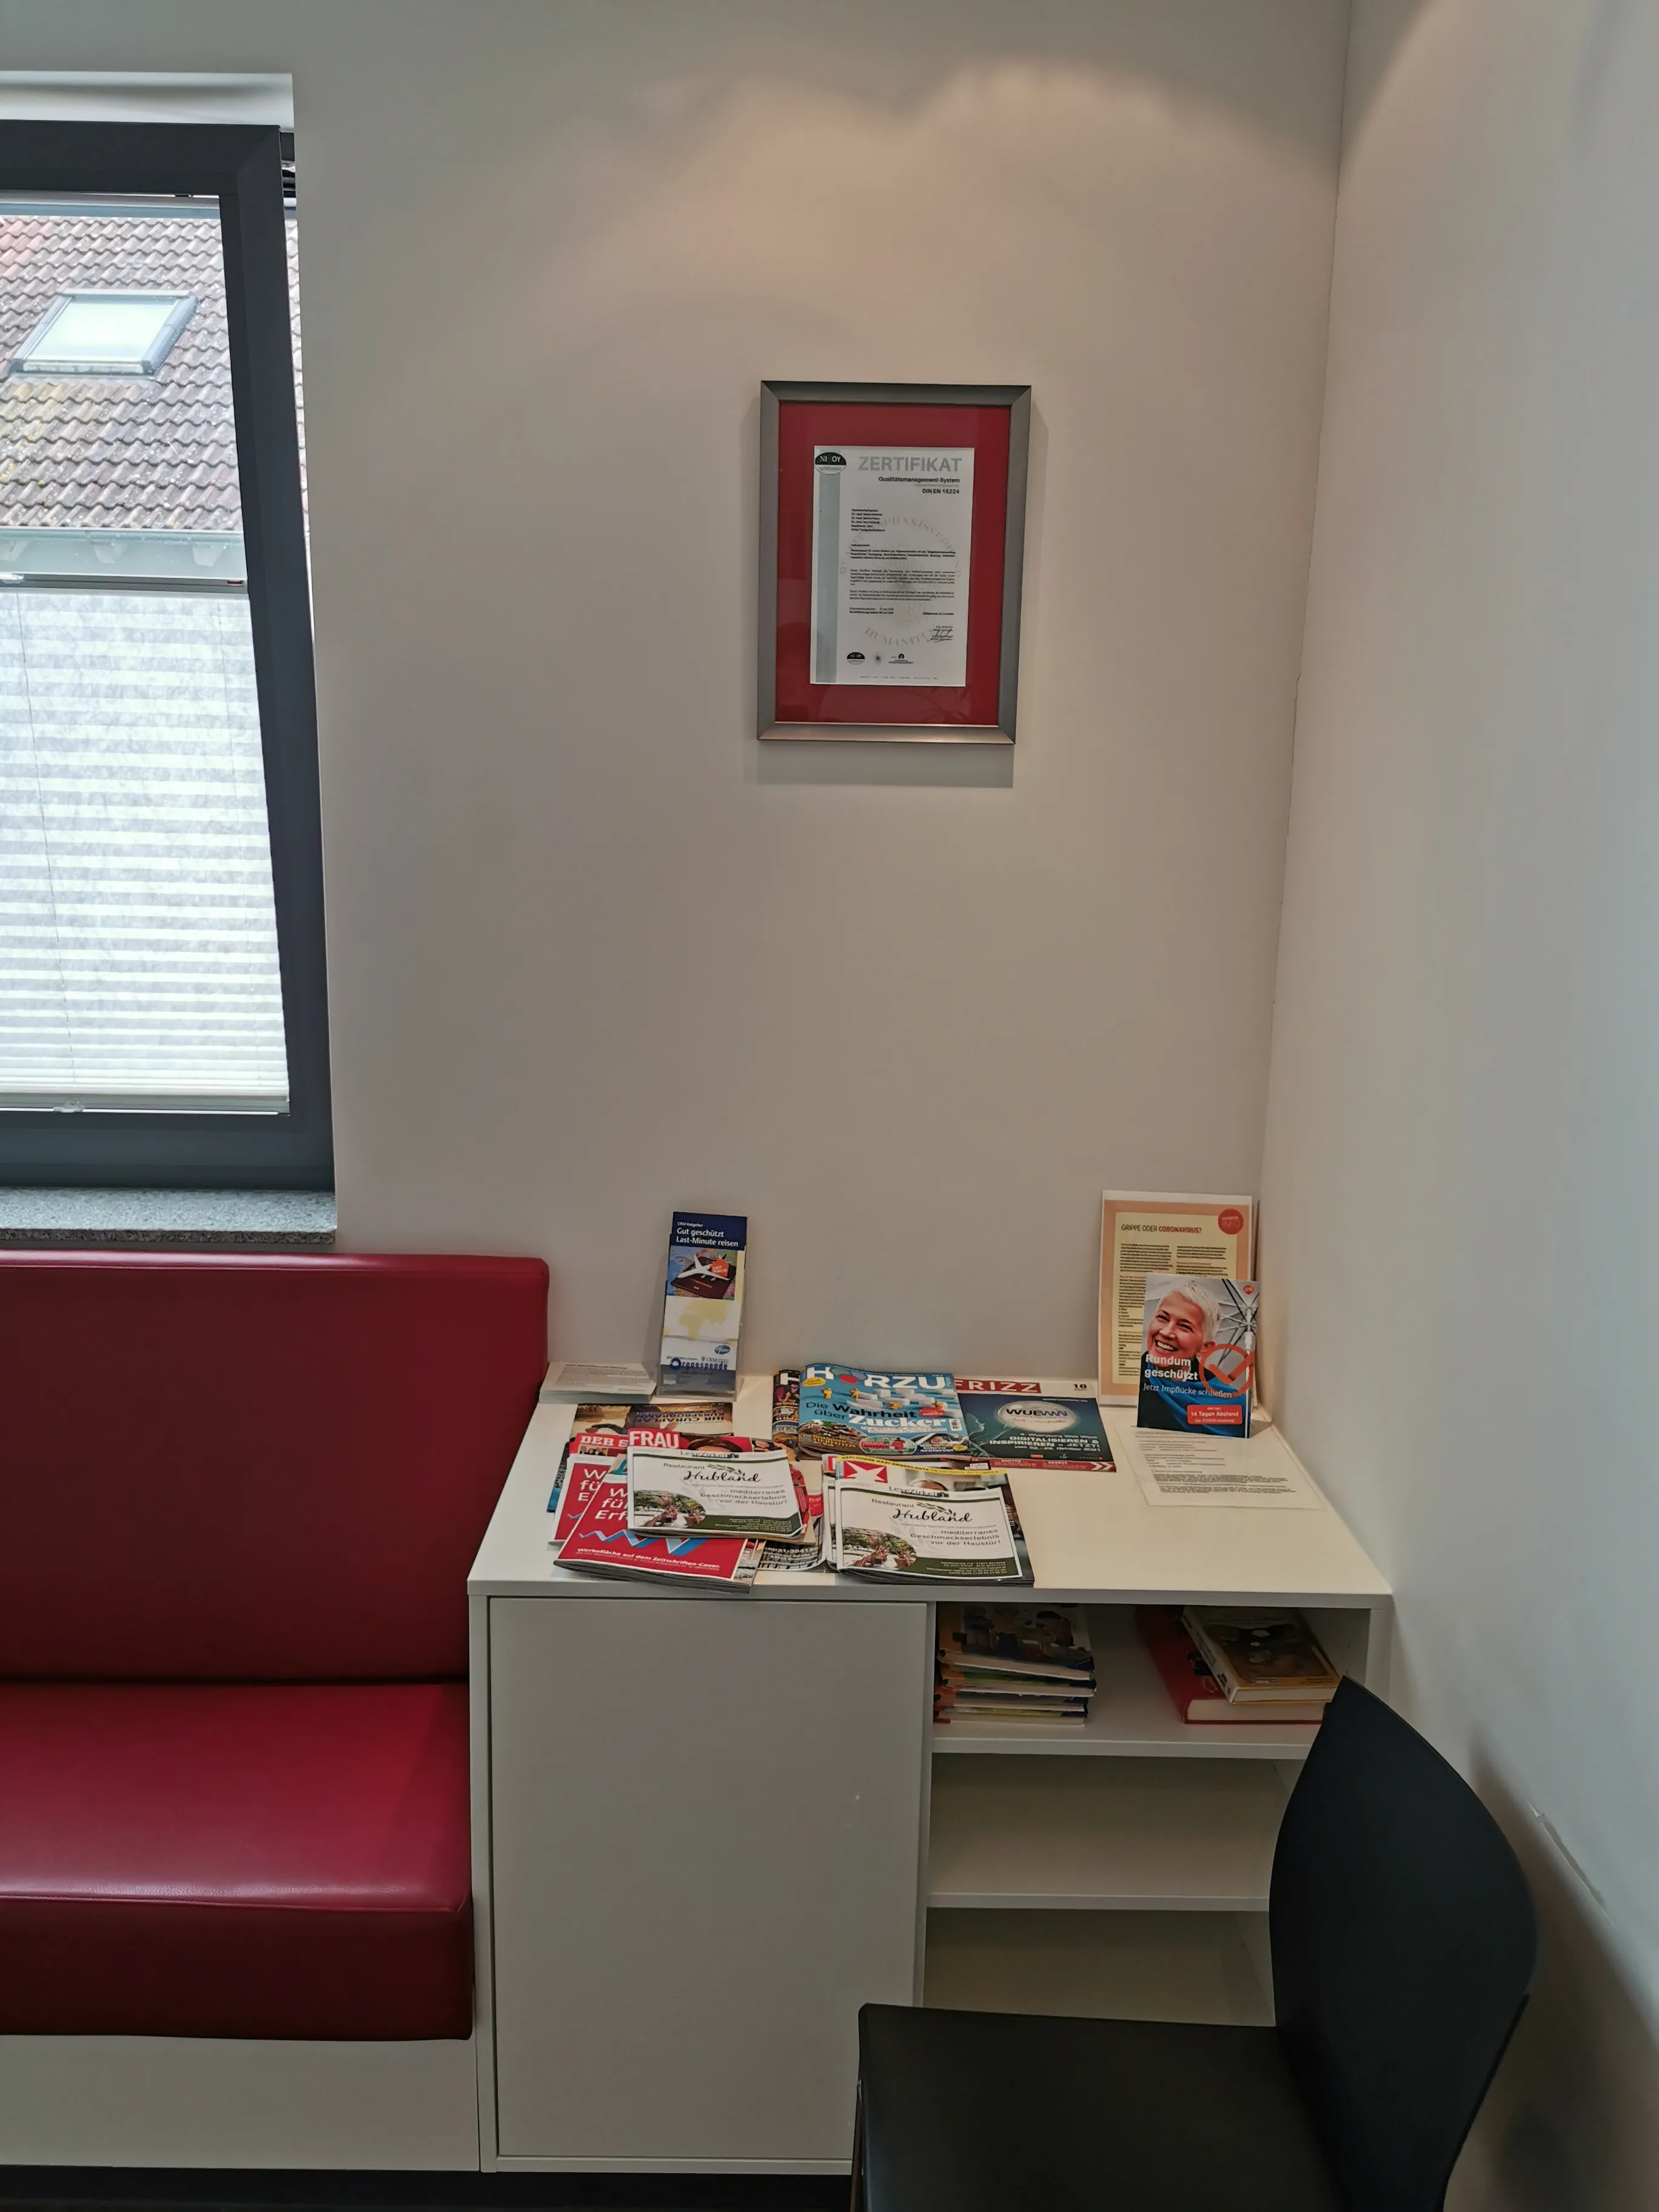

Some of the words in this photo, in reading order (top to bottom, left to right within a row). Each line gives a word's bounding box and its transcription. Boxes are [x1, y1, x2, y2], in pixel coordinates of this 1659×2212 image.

[858, 456, 962, 472] ZERTIFIKAT
[691, 1228, 725, 1238] geschützt
[676, 1236, 717, 1245] Last-Minute
[669, 1357, 728, 1371] Organspende
[1145, 1353, 1191, 1367] Rundum
[1144, 1369, 1198, 1381] geschützt
[954, 1379, 1038, 1393] FRIZZ
[1143, 1382, 1159, 1391] Jetzt
[1161, 1385, 1196, 1394] Impflücke
[1198, 1390, 1232, 1398] schließen
[833, 1403, 918, 1418] Wahrheit
[814, 1409, 849, 1419] über
[848, 1413, 947, 1427] Zucker
[580, 1435, 615, 1447] DER
[629, 1430, 680, 1449] FRAU
[683, 1470, 762, 1483] Hubland
[871, 1498, 914, 1509] Restaurant
[892, 1509, 973, 1523] Hubland
[577, 1547, 622, 1557] Werbefläche
[652, 1556, 720, 1569] Zeitschriften-Cover.
